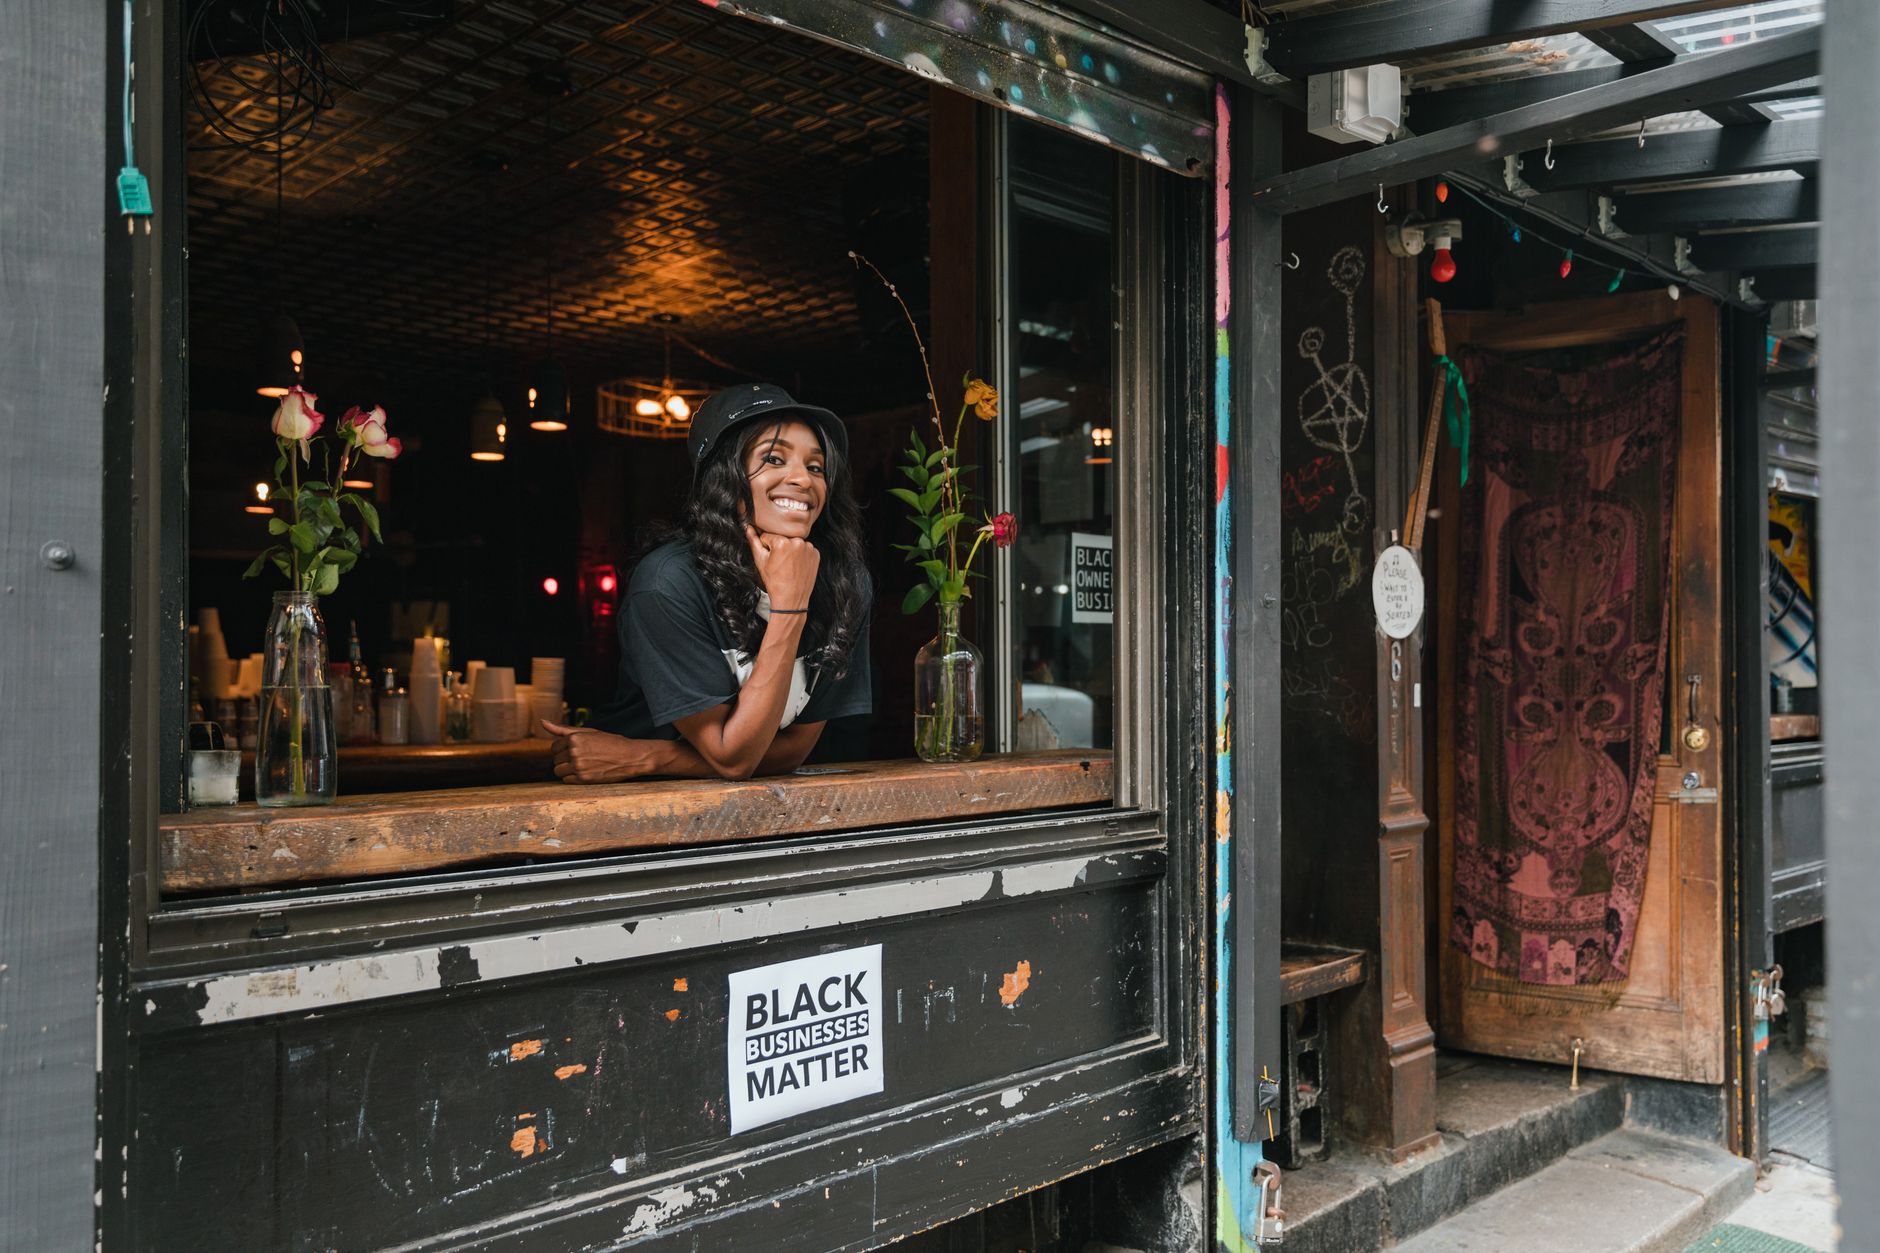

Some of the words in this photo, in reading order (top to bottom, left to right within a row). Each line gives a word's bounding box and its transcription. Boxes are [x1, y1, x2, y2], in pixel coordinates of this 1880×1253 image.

[1077, 548, 1112, 567] BLAC
[1077, 570, 1112, 588] OWNE
[1383, 561, 1407, 579] PLEASE
[1400, 584, 1407, 592] TO
[1077, 591, 1112, 610] BUSI
[746, 970, 868, 1031] BLACK
[746, 1012, 869, 1062] BUSINESSES
[746, 1043, 869, 1102] MATTER
